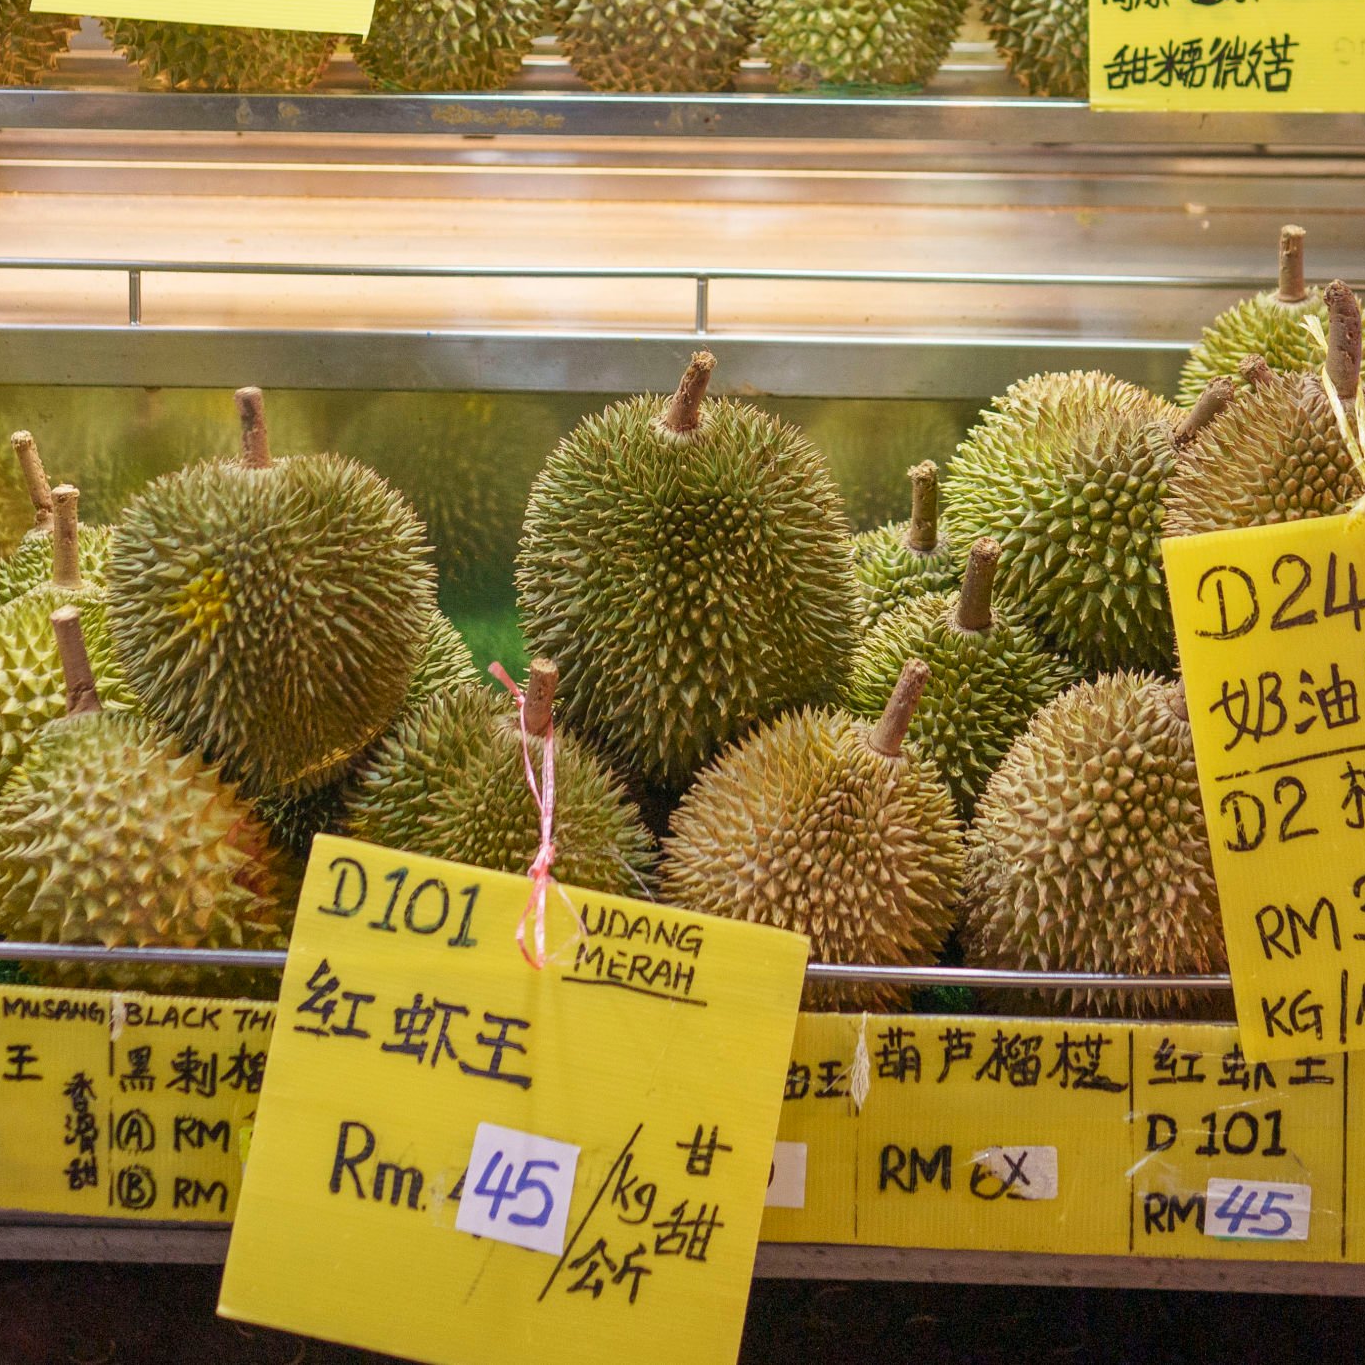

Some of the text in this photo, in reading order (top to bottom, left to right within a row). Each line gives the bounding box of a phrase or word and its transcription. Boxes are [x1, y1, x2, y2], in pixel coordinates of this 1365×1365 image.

[1102, 33, 1300, 94] 甜糯微苦
[1219, 775, 1320, 852] D2
[317, 856, 482, 948] D101
[580, 902, 704, 959] UDANG
[1254, 895, 1342, 962] RM
[573, 944, 697, 995] MERAH
[1, 995, 108, 1027] MUSANG
[123, 1001, 223, 1032] BLACK
[293, 958, 534, 1090] 红虾王
[173, 1116, 231, 1154] RM
[172, 1177, 229, 1214] RM
[473, 1151, 561, 1228] 45
[878, 1143, 952, 1196] RM
[1144, 1185, 1295, 1235] RM 45
[566, 1237, 653, 1305] 公斤
